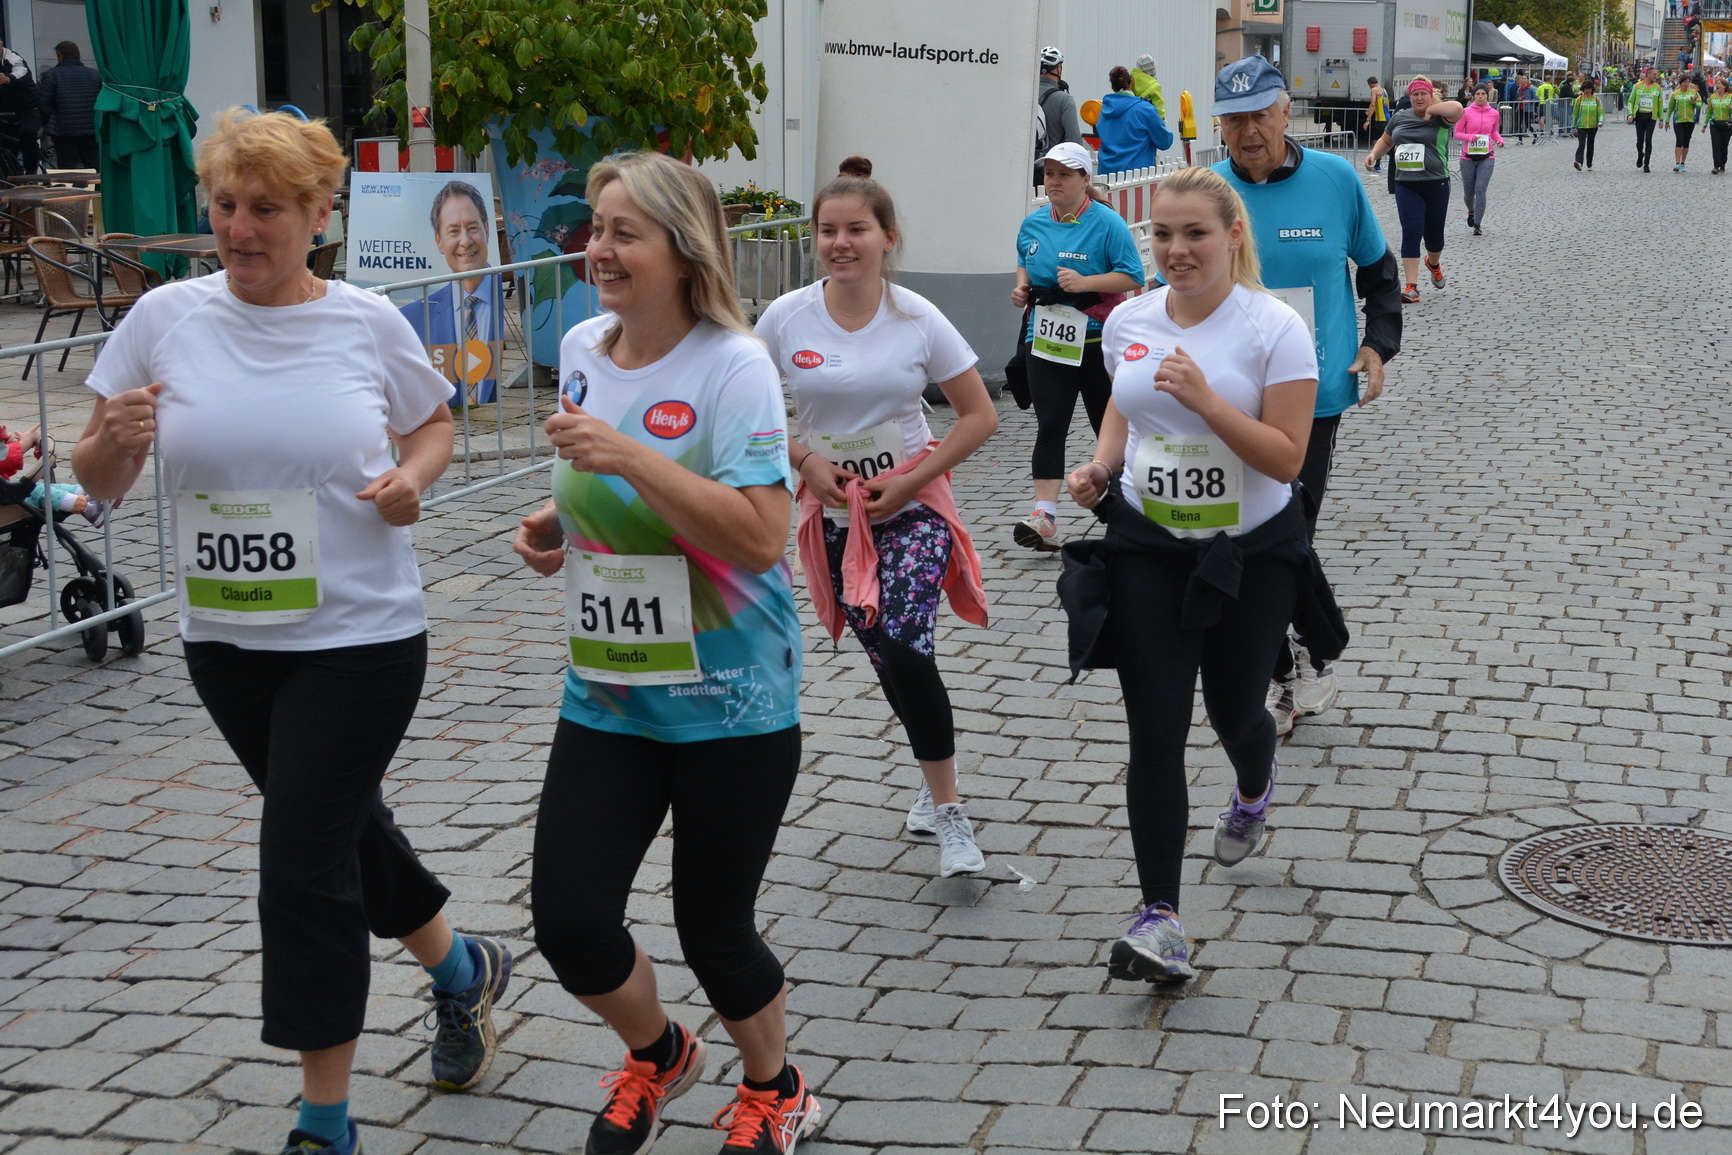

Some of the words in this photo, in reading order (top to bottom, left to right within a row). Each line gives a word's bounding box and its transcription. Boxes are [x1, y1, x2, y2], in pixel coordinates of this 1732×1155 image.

[1446, 14, 1466, 41] BOCK
[824, 40, 999, 64] www.bmw-laufsport.de
[1399, 152, 1420, 161] 5217
[1279, 228, 1322, 238] BOCK
[359, 240, 416, 254] WEITER.
[359, 255, 432, 269] MACHEN.
[1058, 251, 1088, 261] BOCK
[1040, 318, 1076, 342] 5148
[1046, 343, 1062, 352] Nicole
[431, 349, 445, 365] S
[795, 354, 822, 365] Hervis
[650, 409, 689, 430] Hervis
[1148, 466, 1225, 499] 5138
[222, 505, 270, 514] BOCK
[1171, 510, 1200, 521] Elena
[196, 532, 296, 573] 5058
[602, 567, 645, 578] BOCK
[221, 586, 272, 601] Claudia
[581, 592, 664, 635] 5141
[606, 648, 648, 663] Gunda
[668, 684, 732, 697] Stadtlauf
